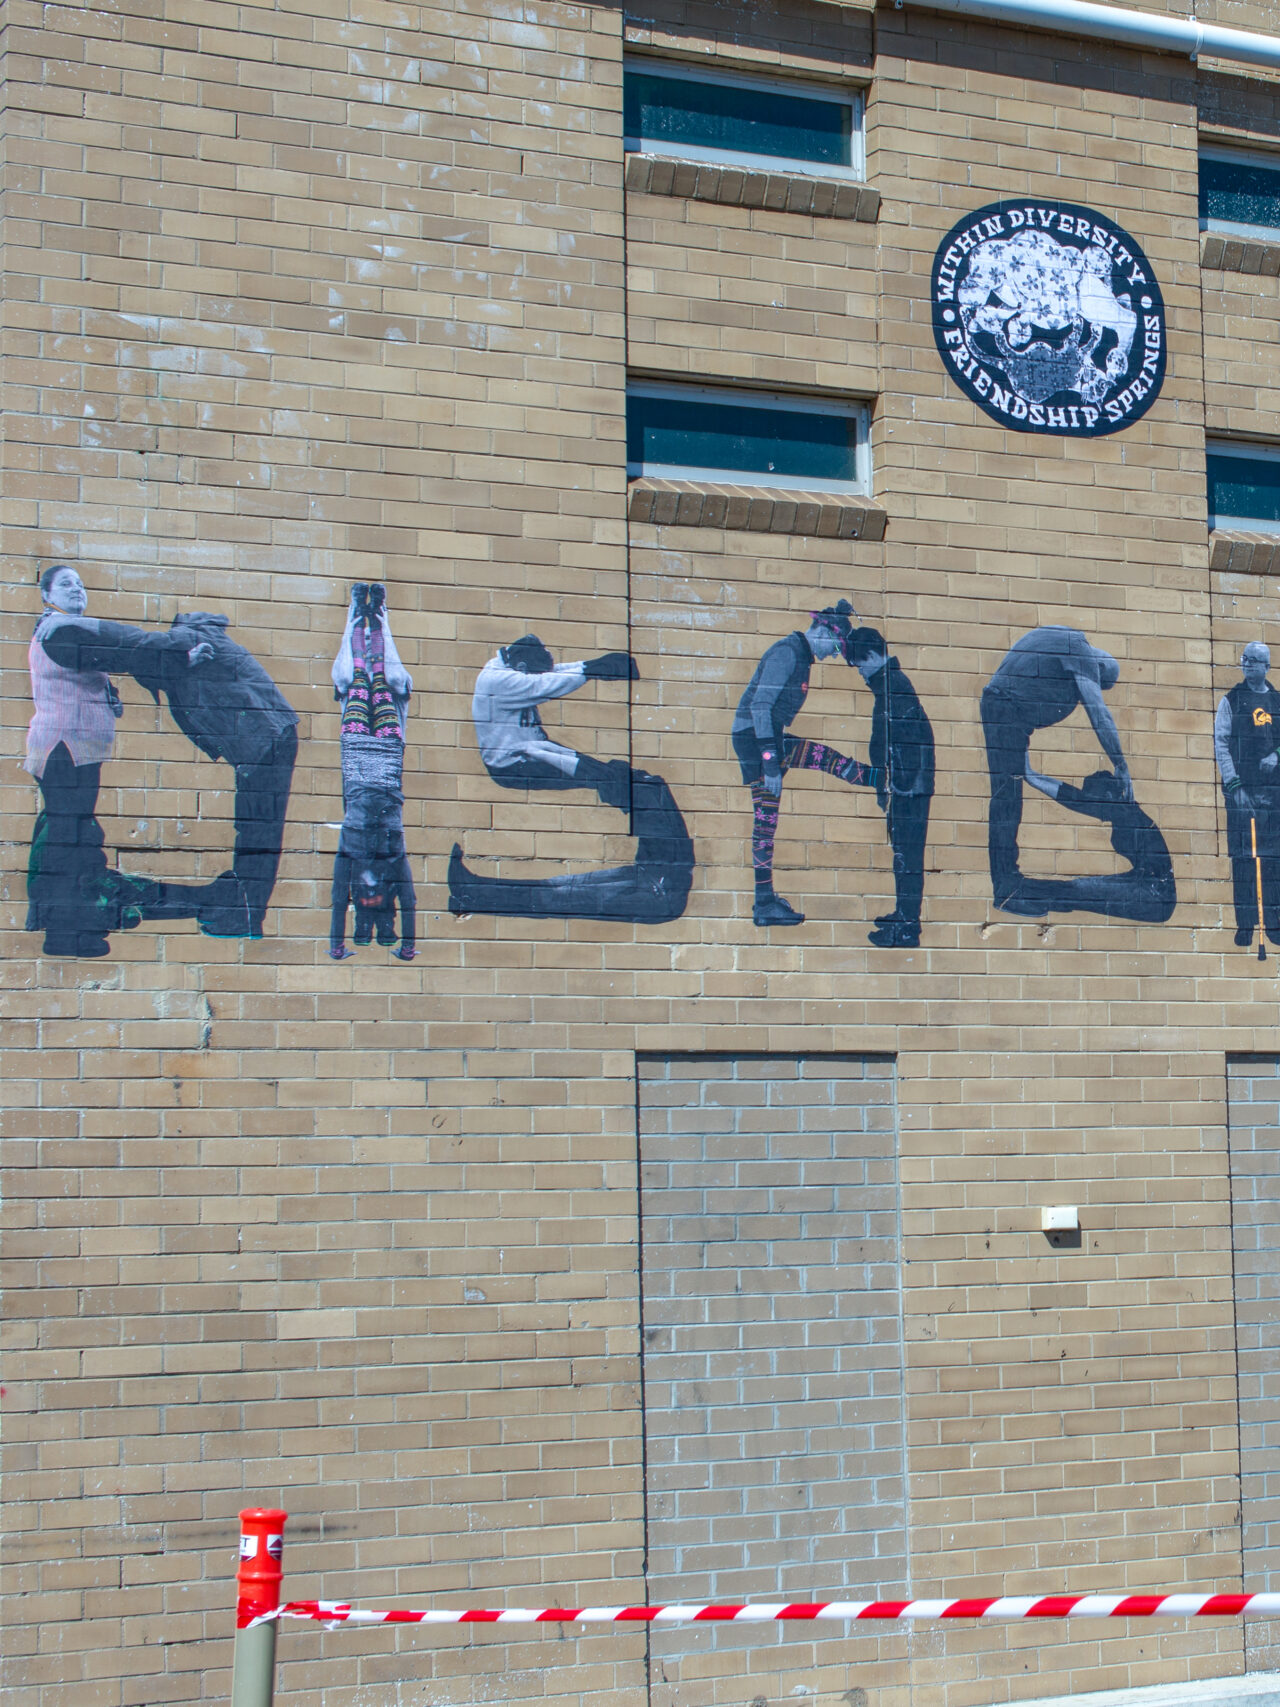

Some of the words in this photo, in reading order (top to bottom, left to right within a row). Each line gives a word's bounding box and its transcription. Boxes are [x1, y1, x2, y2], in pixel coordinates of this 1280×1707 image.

[937, 215, 1005, 303] WITHIN
[1007, 207, 1147, 287] DIVERSITY
[943, 328, 1100, 428] FRIENDSHIP
[1105, 314, 1161, 423] SPRINGS
